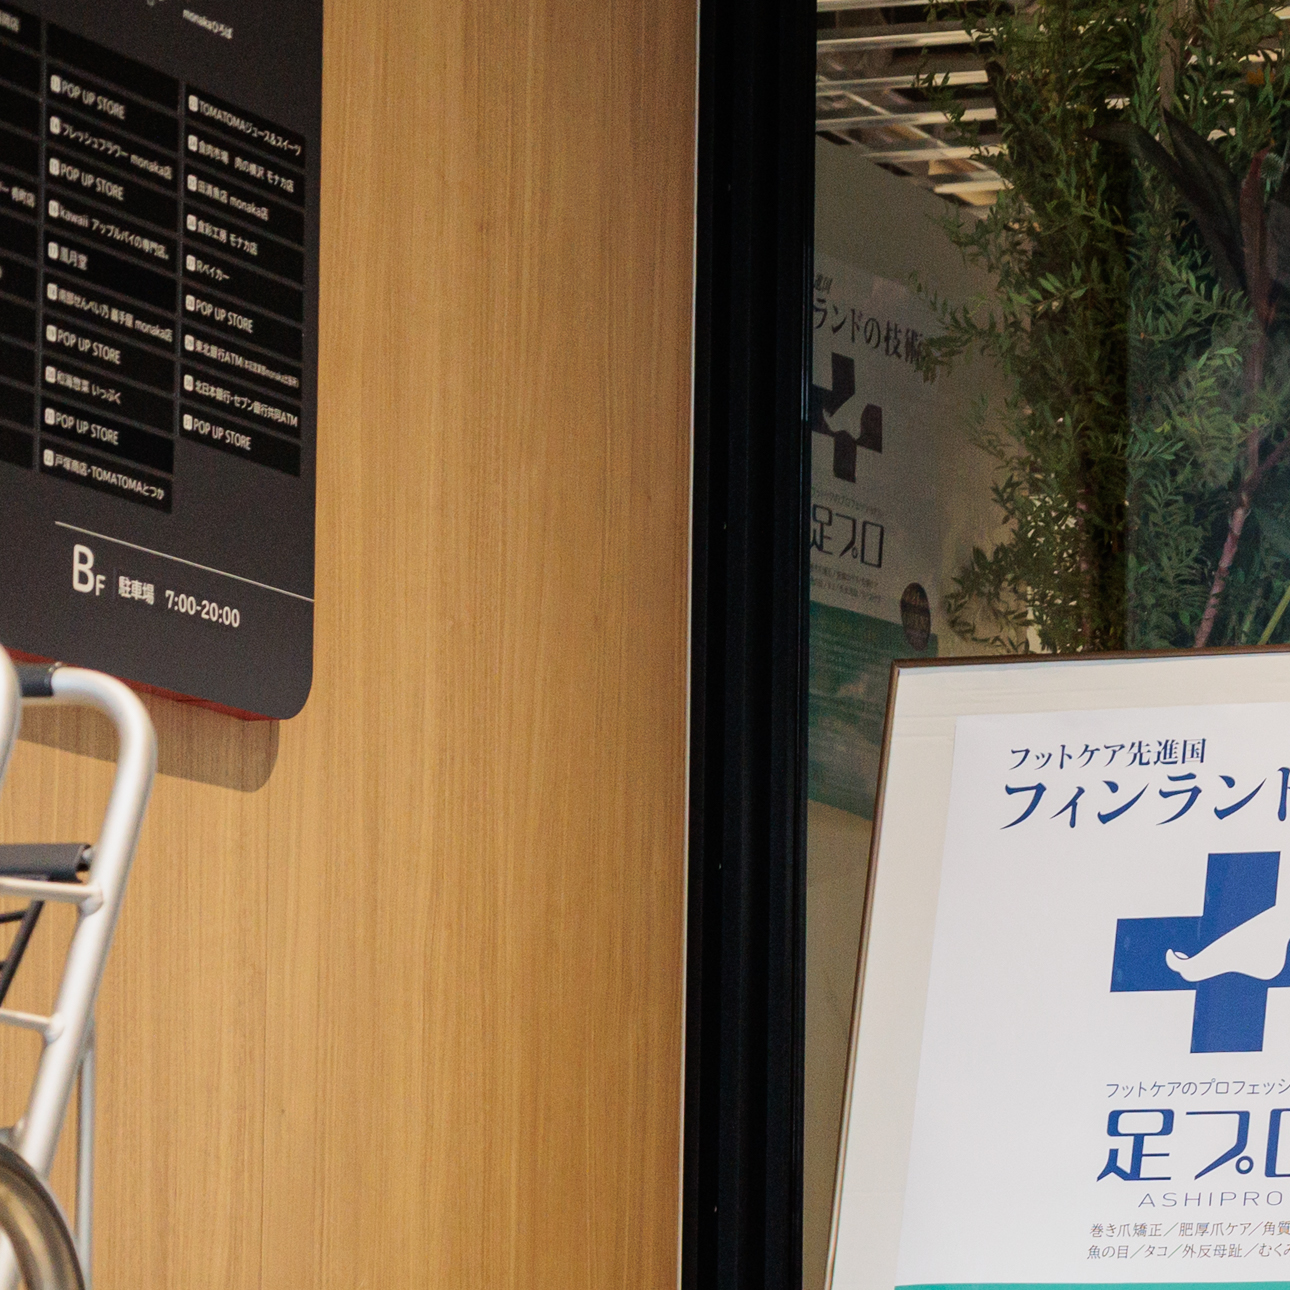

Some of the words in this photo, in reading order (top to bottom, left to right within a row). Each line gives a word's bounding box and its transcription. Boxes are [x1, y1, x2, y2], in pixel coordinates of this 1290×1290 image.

[61, 81, 81, 99] POP
[82, 89, 96, 106] UP
[97, 96, 126, 120] STORE
[61, 163, 80, 181] POP
[81, 171, 95, 188] UP
[95, 177, 124, 200] STORE
[60, 204, 89, 228] kawaii
[196, 299, 213, 317] POP
[214, 307, 226, 321] UP
[228, 312, 253, 334] STORE
[57, 329, 76, 347] POP
[78, 337, 91, 352] UP
[92, 342, 121, 365] STORE
[55, 412, 74, 430] POP
[76, 420, 89, 434] UP
[90, 424, 119, 446] STORE
[193, 418, 211, 436] POP
[212, 425, 224, 439] UP
[225, 430, 252, 450] STORE
[118, 576, 155, 605] 駐車場
[165, 589, 240, 628] 7:00-20:00
[1009, 738, 1207, 770] フットケア先進国
[1138, 1190, 1284, 1208] ASHIPRO
